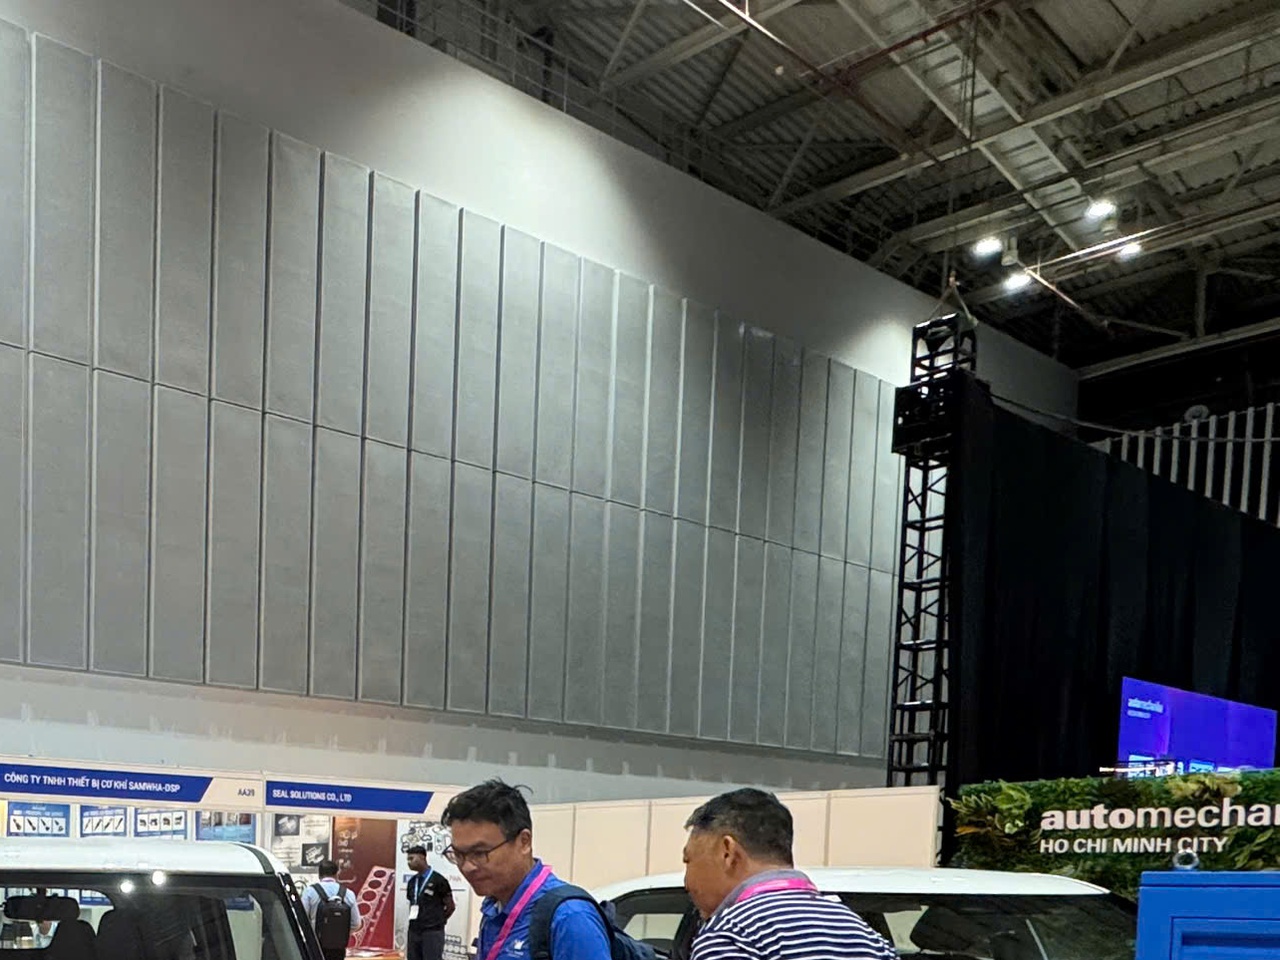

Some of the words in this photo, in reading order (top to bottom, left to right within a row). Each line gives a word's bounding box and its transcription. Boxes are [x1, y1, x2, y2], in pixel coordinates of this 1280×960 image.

[4, 771, 29, 784] CÔNG
[30, 774, 41, 785] TY
[42, 775, 66, 786] TNHH
[128, 781, 181, 793] SAMWHA-DSP
[272, 789, 289, 799] SEAL
[290, 789, 326, 801] SOLUTIONS
[340, 792, 352, 803] LTD
[1040, 838, 1069, 854] HO
[1073, 838, 1107, 854] CHI
[1112, 836, 1171, 854] MINH
[1177, 836, 1229, 854] CITY
